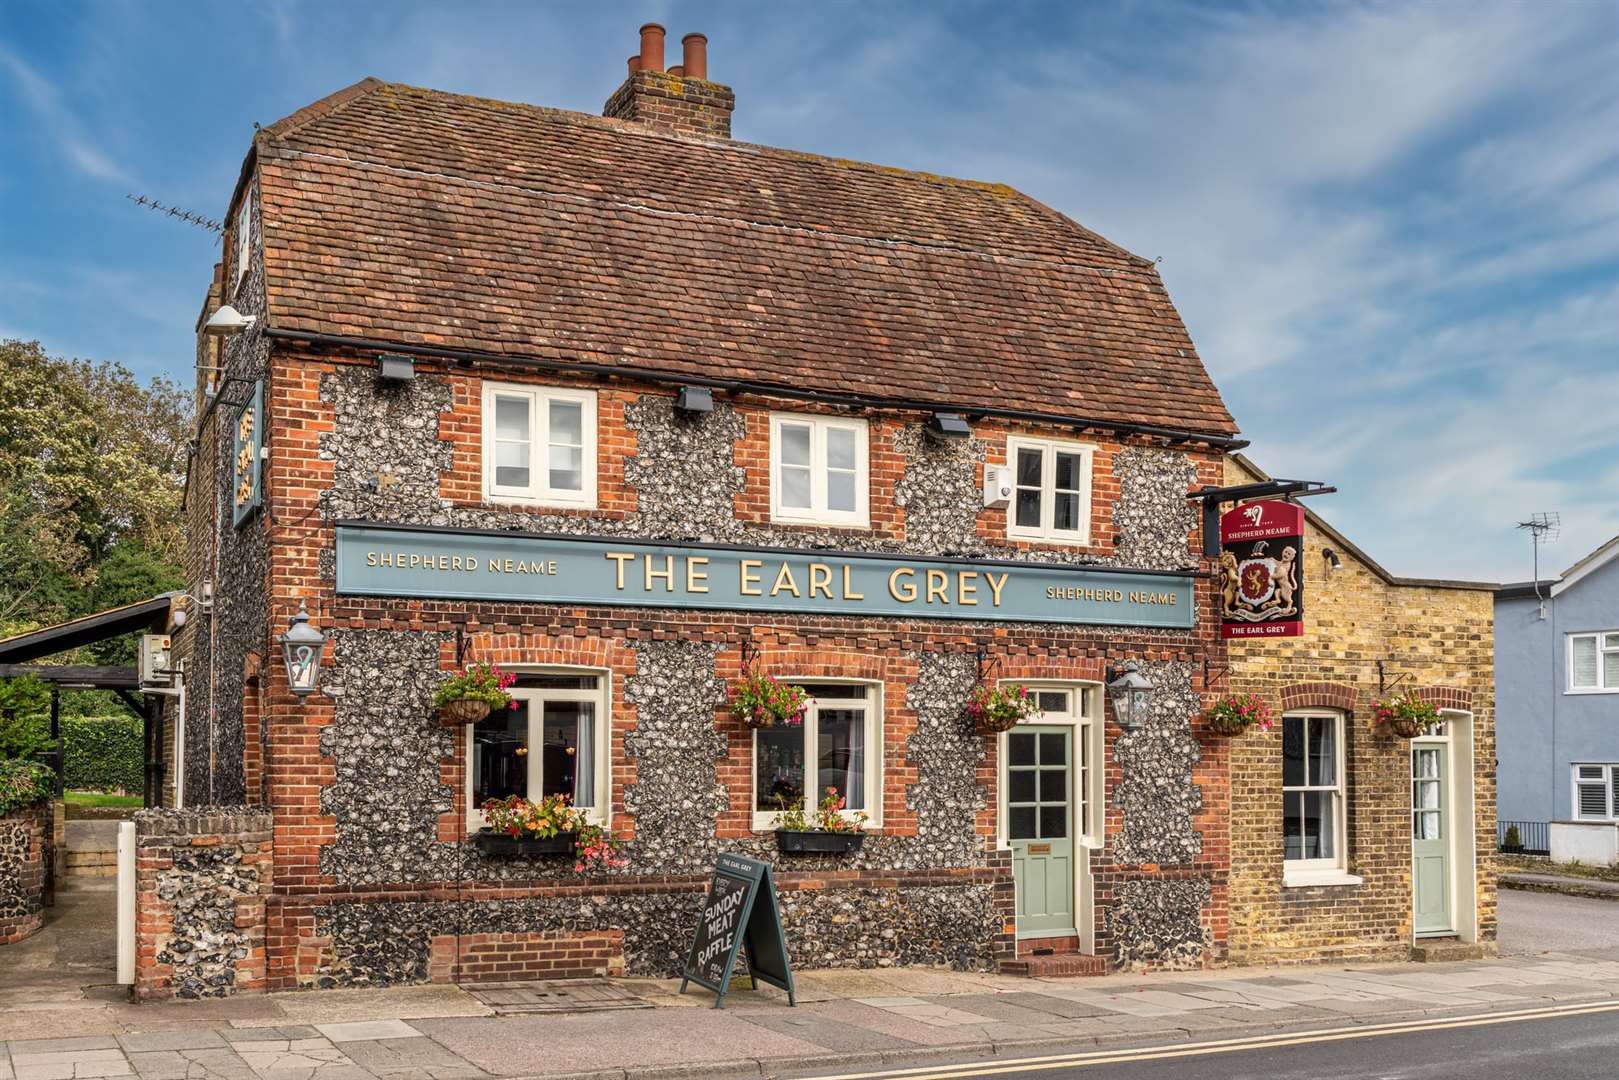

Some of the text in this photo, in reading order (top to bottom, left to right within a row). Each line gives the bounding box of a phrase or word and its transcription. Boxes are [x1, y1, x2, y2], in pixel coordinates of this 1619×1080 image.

[1265, 526, 1290, 535] NEAME
[366, 552, 558, 575] SHEPHERD NEAME
[605, 552, 1009, 606] THE EARL GREY
[1046, 586, 1177, 606] SHEPHERD NEAME
[704, 886, 744, 923] SUNDAY
[708, 909, 736, 939] MEAT
[697, 932, 733, 967] RAFFLE
